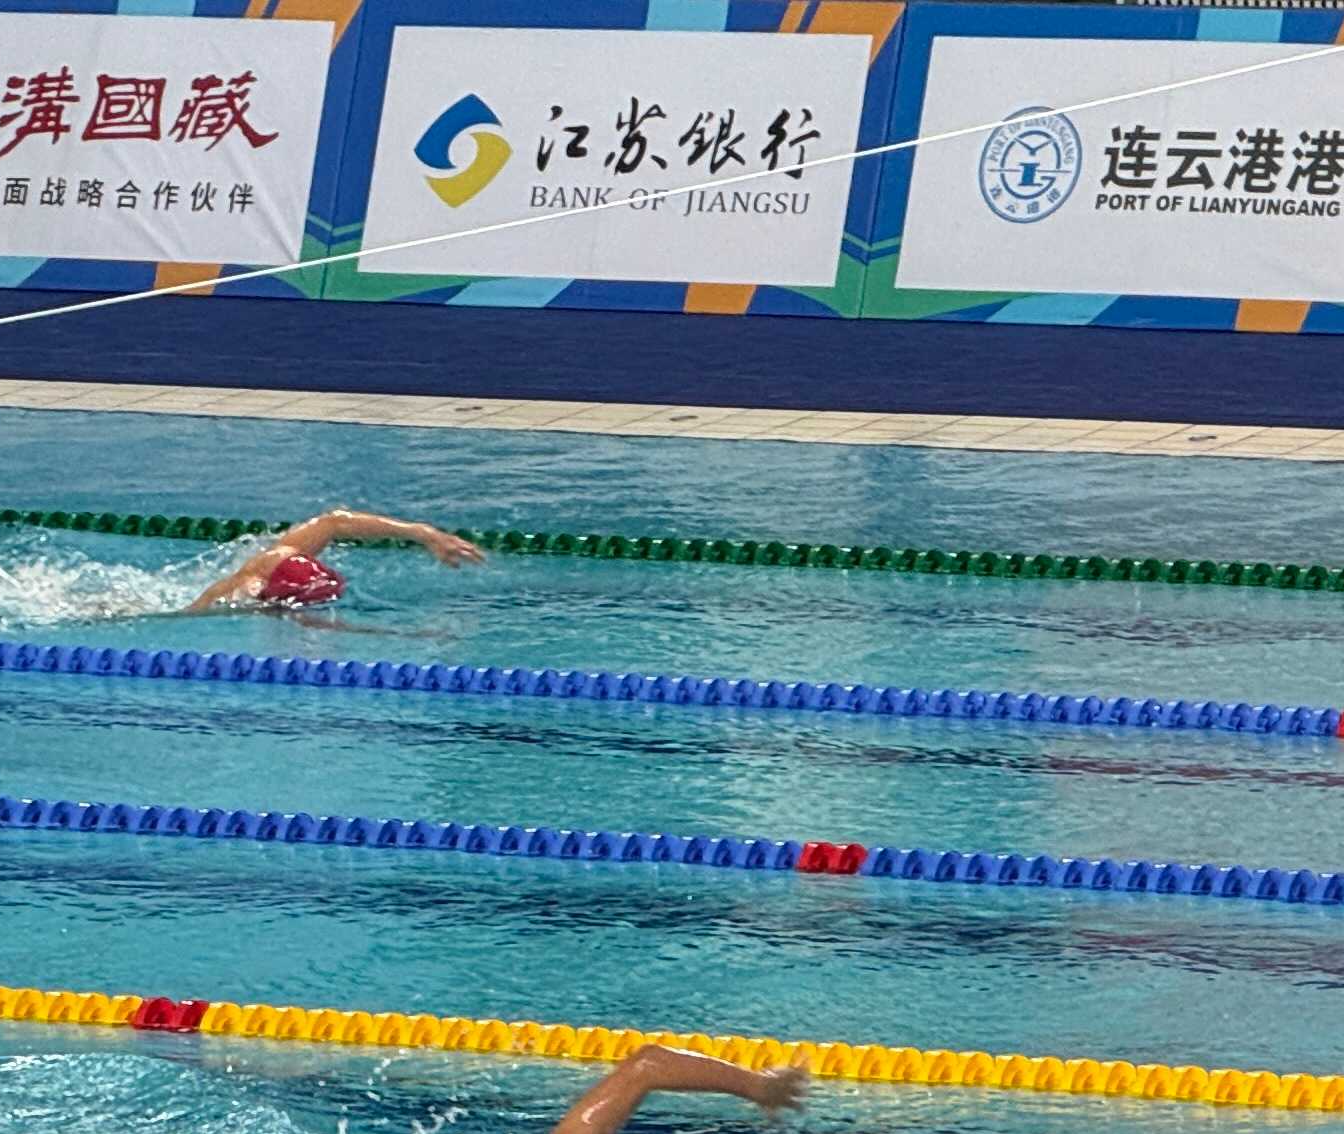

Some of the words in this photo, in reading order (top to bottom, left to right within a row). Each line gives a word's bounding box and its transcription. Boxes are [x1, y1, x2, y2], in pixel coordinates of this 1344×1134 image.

[529, 185, 613, 209] BANK
[629, 188, 668, 211] OF
[684, 191, 811, 216] JIANGSU
[1095, 194, 1151, 211] PORT
[1156, 195, 1184, 212] OF
[1188, 196, 1342, 217] LIANYUNGANG
